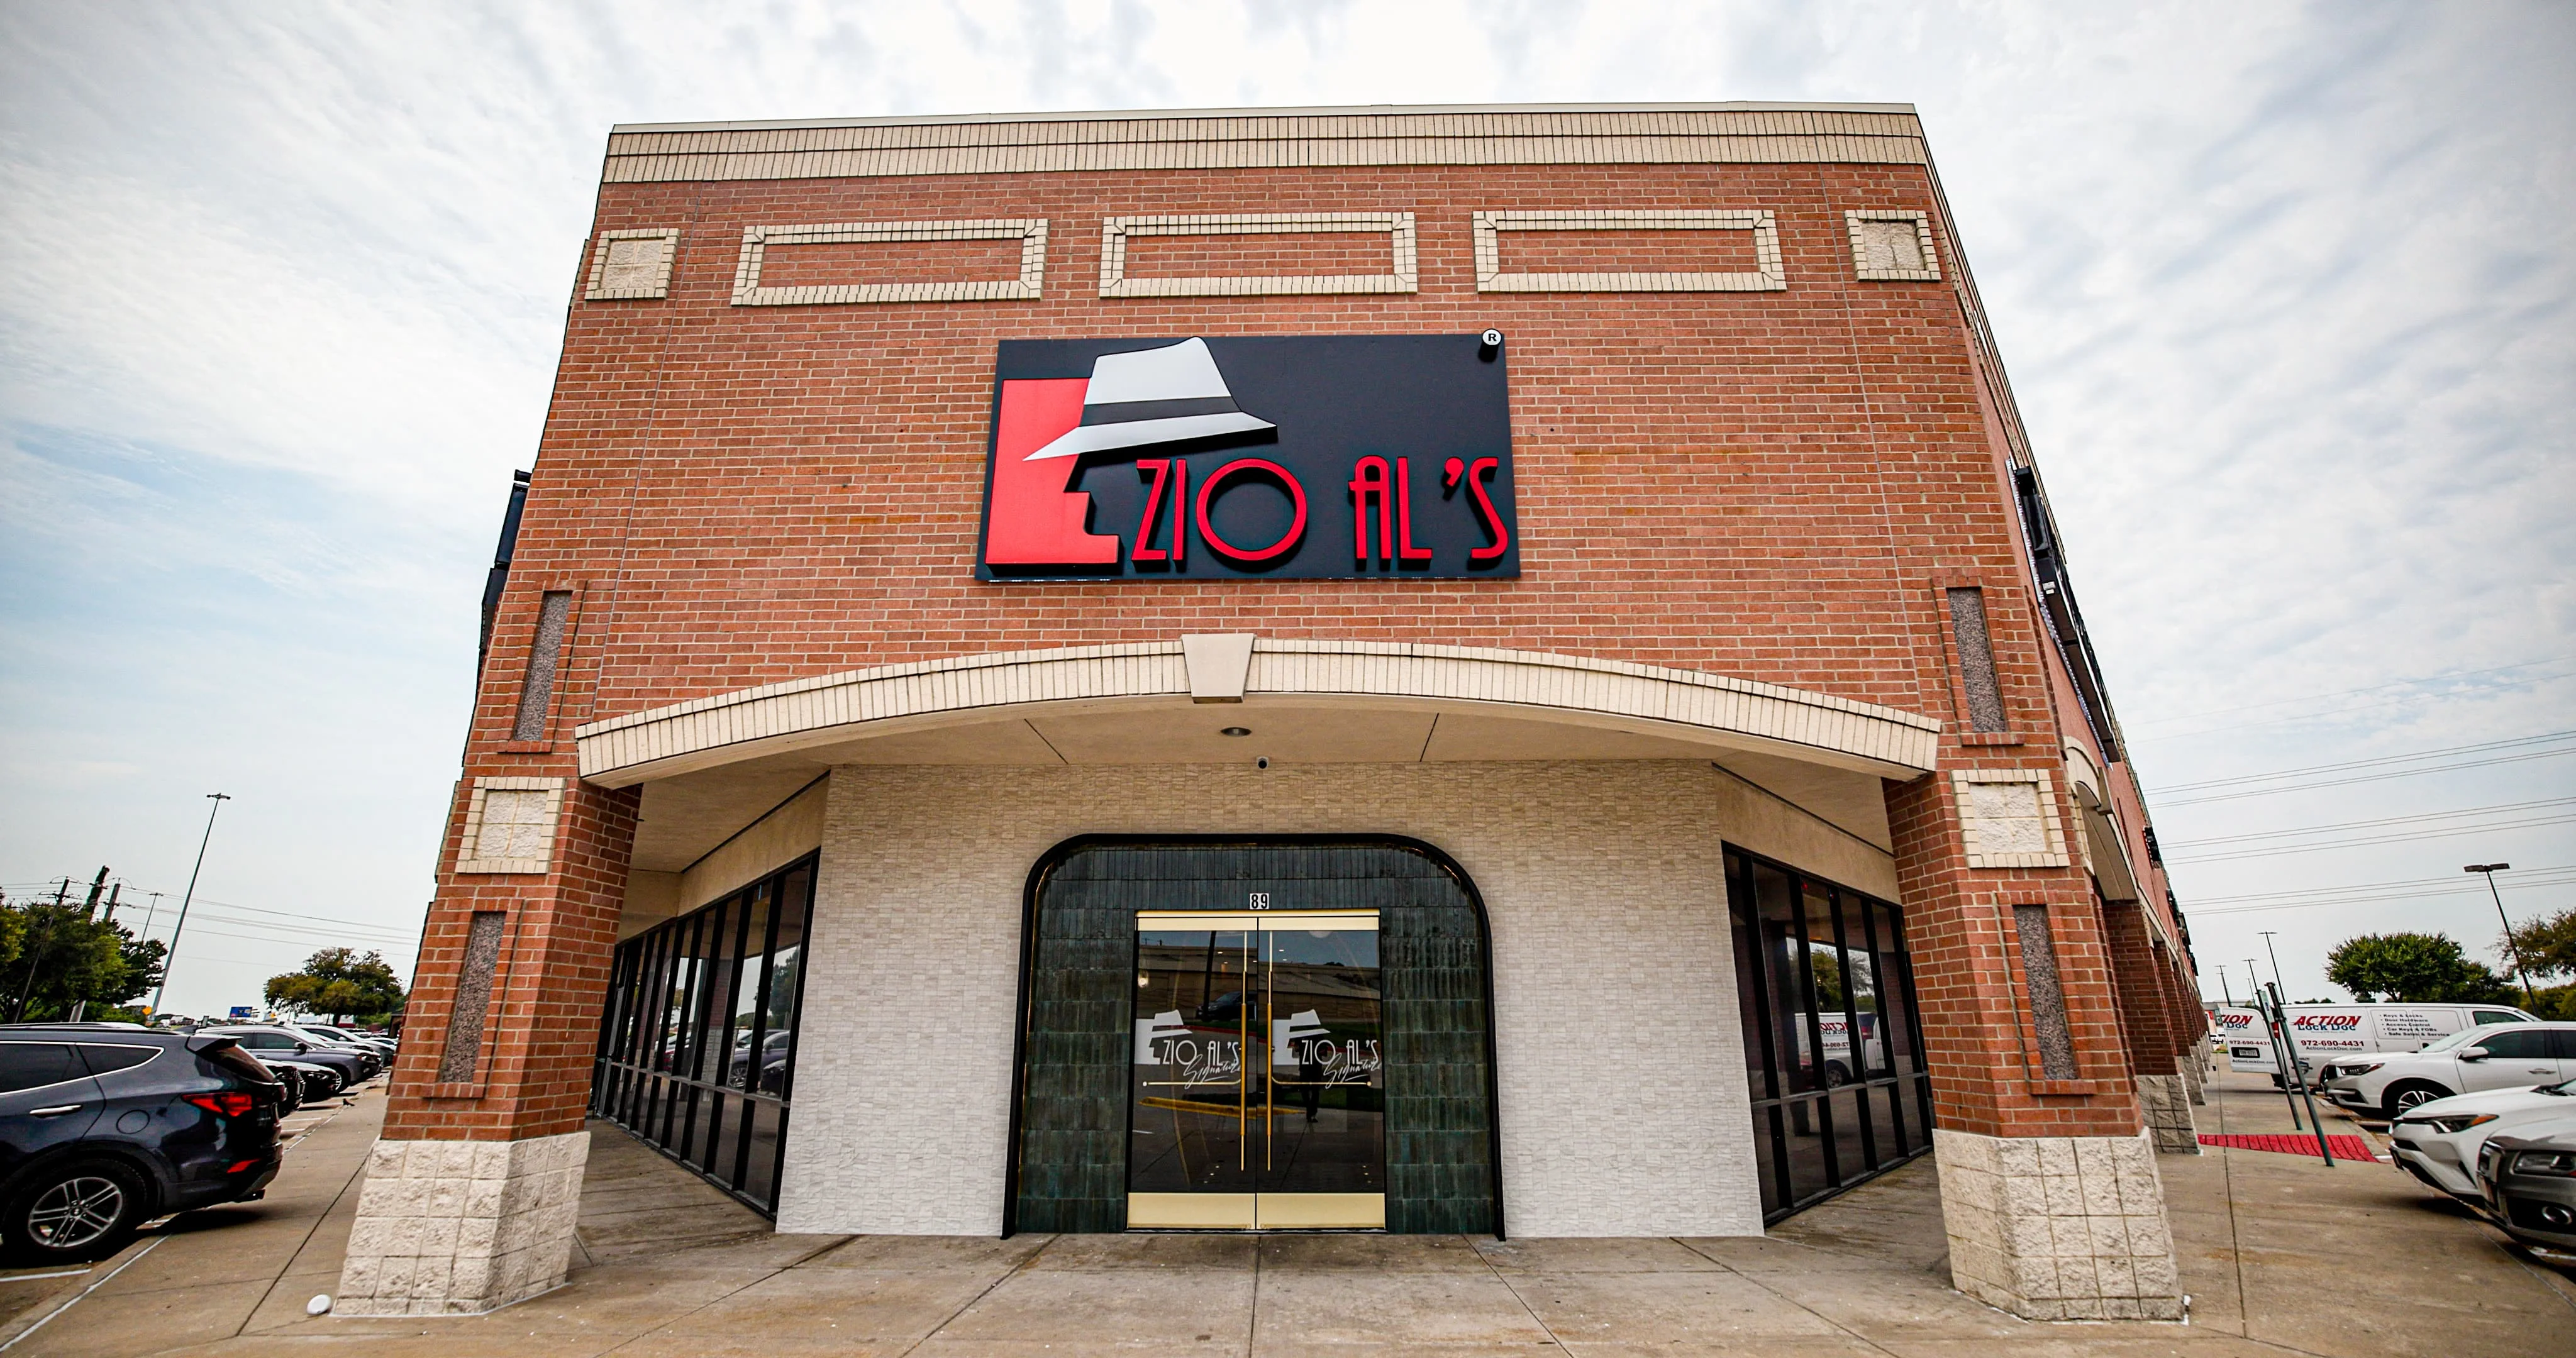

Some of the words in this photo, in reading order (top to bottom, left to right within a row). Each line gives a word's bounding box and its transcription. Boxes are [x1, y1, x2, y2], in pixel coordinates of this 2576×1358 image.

[1133, 457, 1307, 561] ZIO
[1349, 455, 1509, 560] AL'S
[1252, 894, 1268, 908] 89
[2294, 1015, 2362, 1025] ACTION
[1162, 1040, 1197, 1065] ZIO
[1301, 1039, 1336, 1065] ZIO
[1323, 1052, 1382, 1090] Signature
